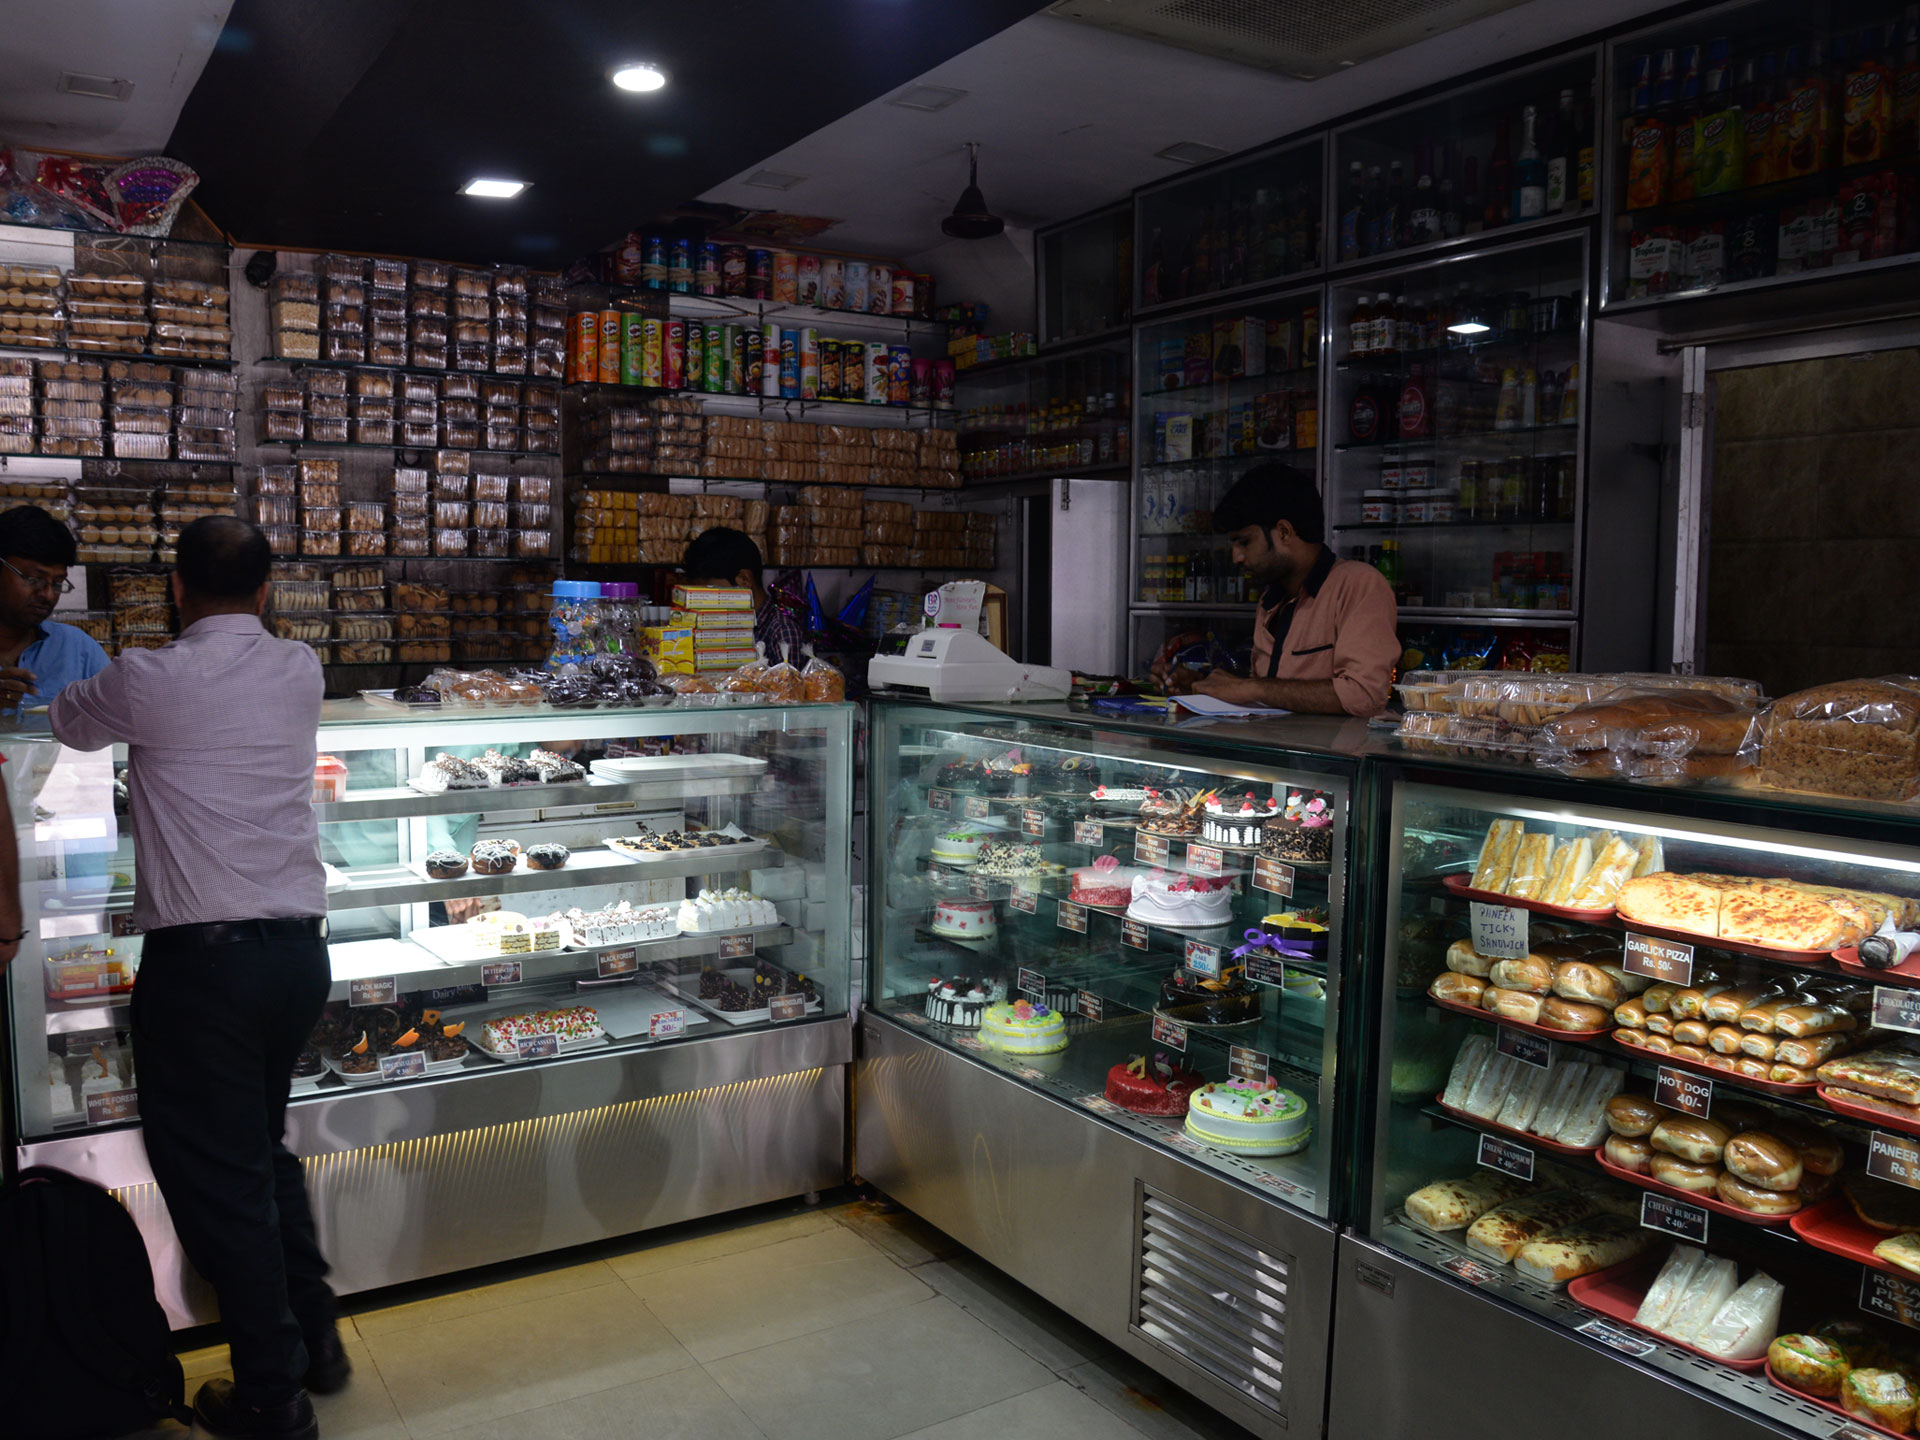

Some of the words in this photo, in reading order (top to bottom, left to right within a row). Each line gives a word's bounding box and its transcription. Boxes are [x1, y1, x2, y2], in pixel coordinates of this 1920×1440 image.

[721, 936, 753, 946] PINEAPPLE
[1480, 935, 1525, 951] SANDWICH
[600, 956, 616, 964] BLACK
[617, 951, 635, 960] FOREST
[1627, 940, 1664, 958] GARLICK
[1666, 949, 1690, 964] PIZZA
[1642, 956, 1656, 968] Rs.
[1657, 961, 1673, 972] 50/-
[352, 984, 371, 992] BLACK
[372, 982, 392, 990] MAGIC
[432, 989, 456, 1000] Dairy
[1879, 996, 1914, 1009] CHOCOLATE
[520, 1041, 532, 1049] RICH
[1660, 1075, 1682, 1089] HOT
[1684, 1082, 1710, 1098] DOG
[88, 1098, 110, 1108] WHITE
[111, 1095, 138, 1104] FOREST
[1677, 1093, 1703, 1108] 40/-
[1483, 1142, 1503, 1155] CHEESE
[1872, 1140, 1919, 1164] PANEER
[1890, 1162, 1908, 1177] Rs.
[1648, 1200, 1673, 1214] CHEESE
[1675, 1206, 1703, 1223] BURGER
[1873, 1274, 1920, 1297] ROYA
[1871, 1296, 1898, 1313] Rs.
